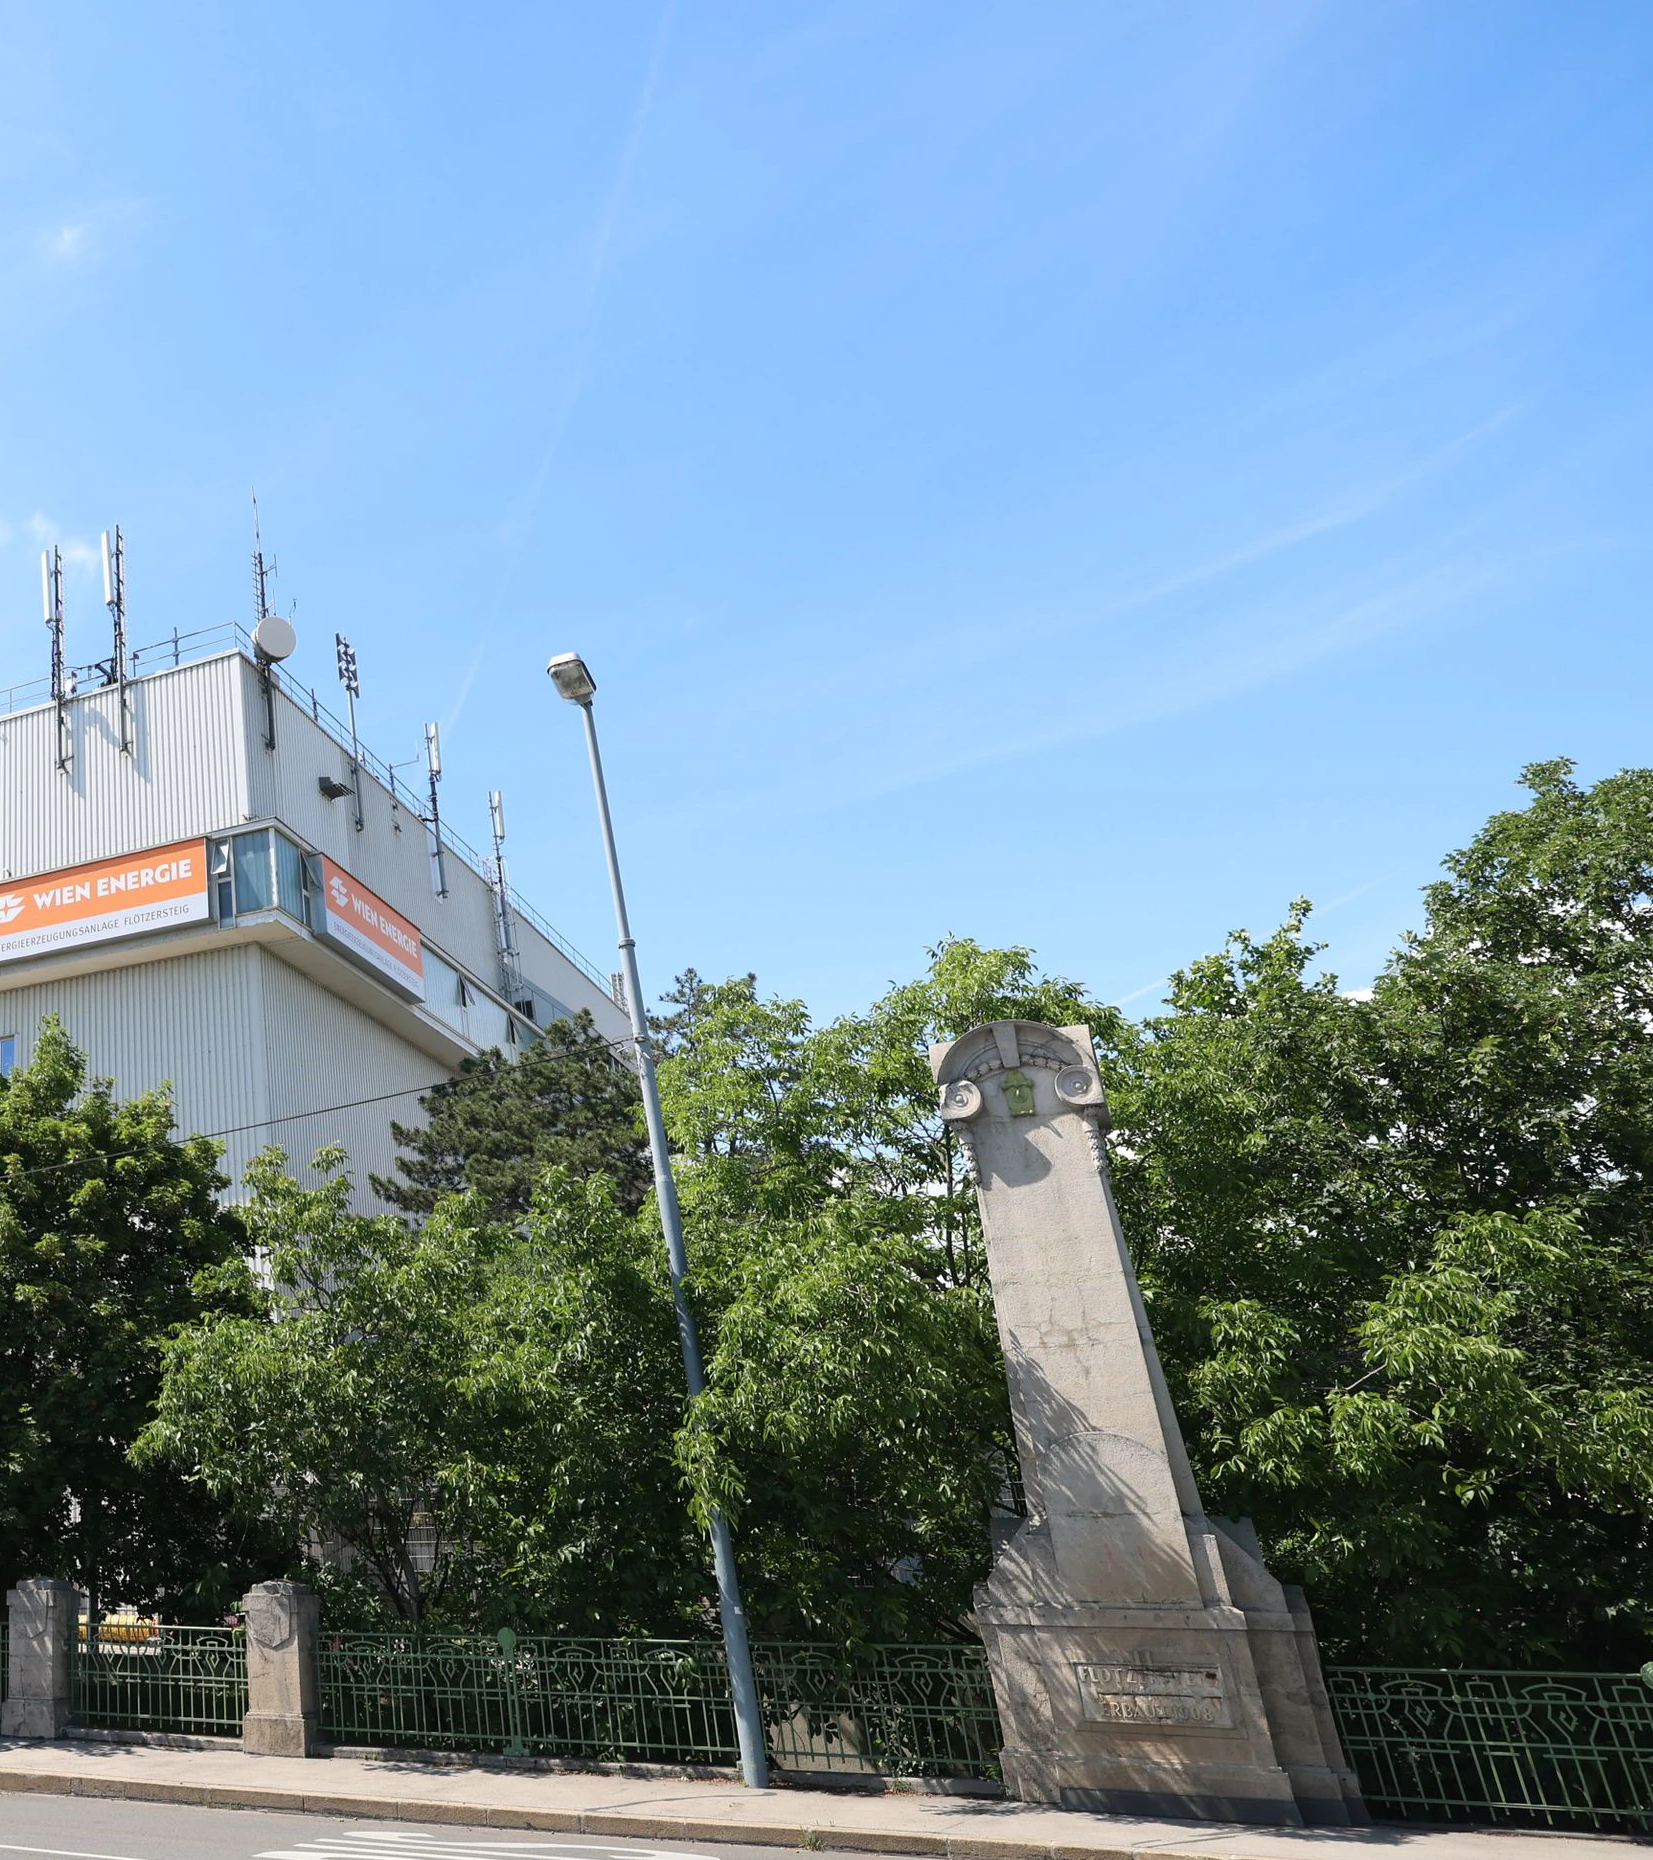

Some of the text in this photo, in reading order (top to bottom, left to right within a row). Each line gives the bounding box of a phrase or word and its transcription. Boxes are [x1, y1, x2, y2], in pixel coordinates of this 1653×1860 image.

[33, 858, 192, 911] WIEN ENERGIE
[123, 904, 190, 927] FLÖTZERSTEIG
[351, 893, 379, 929] WIEN
[379, 915, 418, 958] ENERGIE
